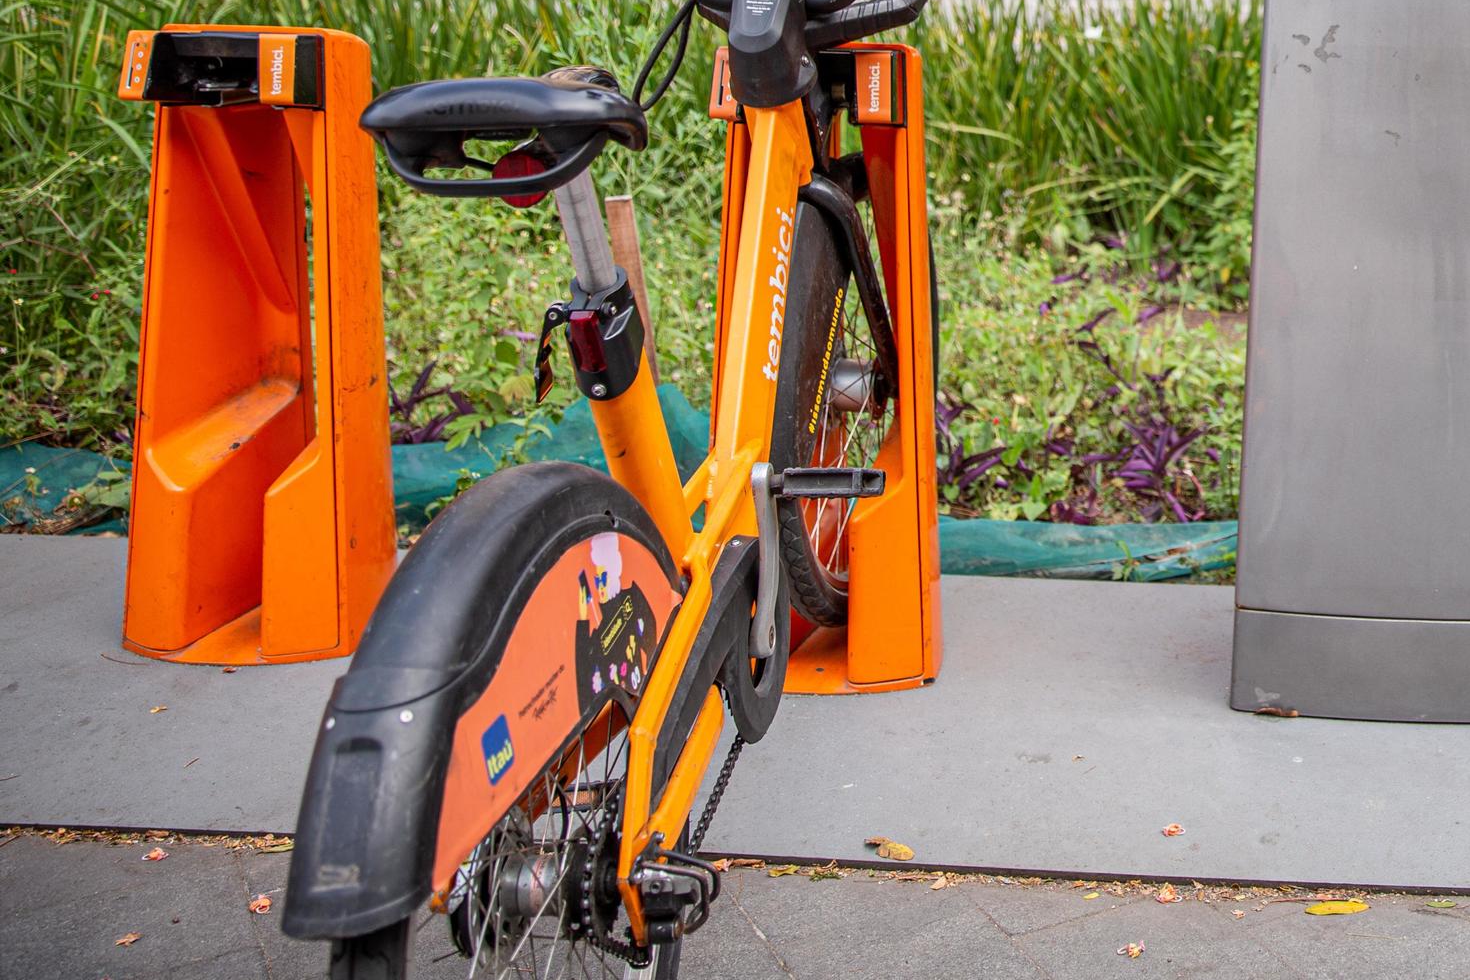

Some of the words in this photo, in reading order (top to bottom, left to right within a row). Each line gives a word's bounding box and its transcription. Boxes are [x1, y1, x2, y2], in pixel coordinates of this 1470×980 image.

[271, 46, 284, 95] tembici.
[869, 62, 880, 113] tembici.
[763, 206, 794, 382] tembici.
[808, 287, 844, 435] #issomudaomundo
[487, 740, 513, 778] Itaú
